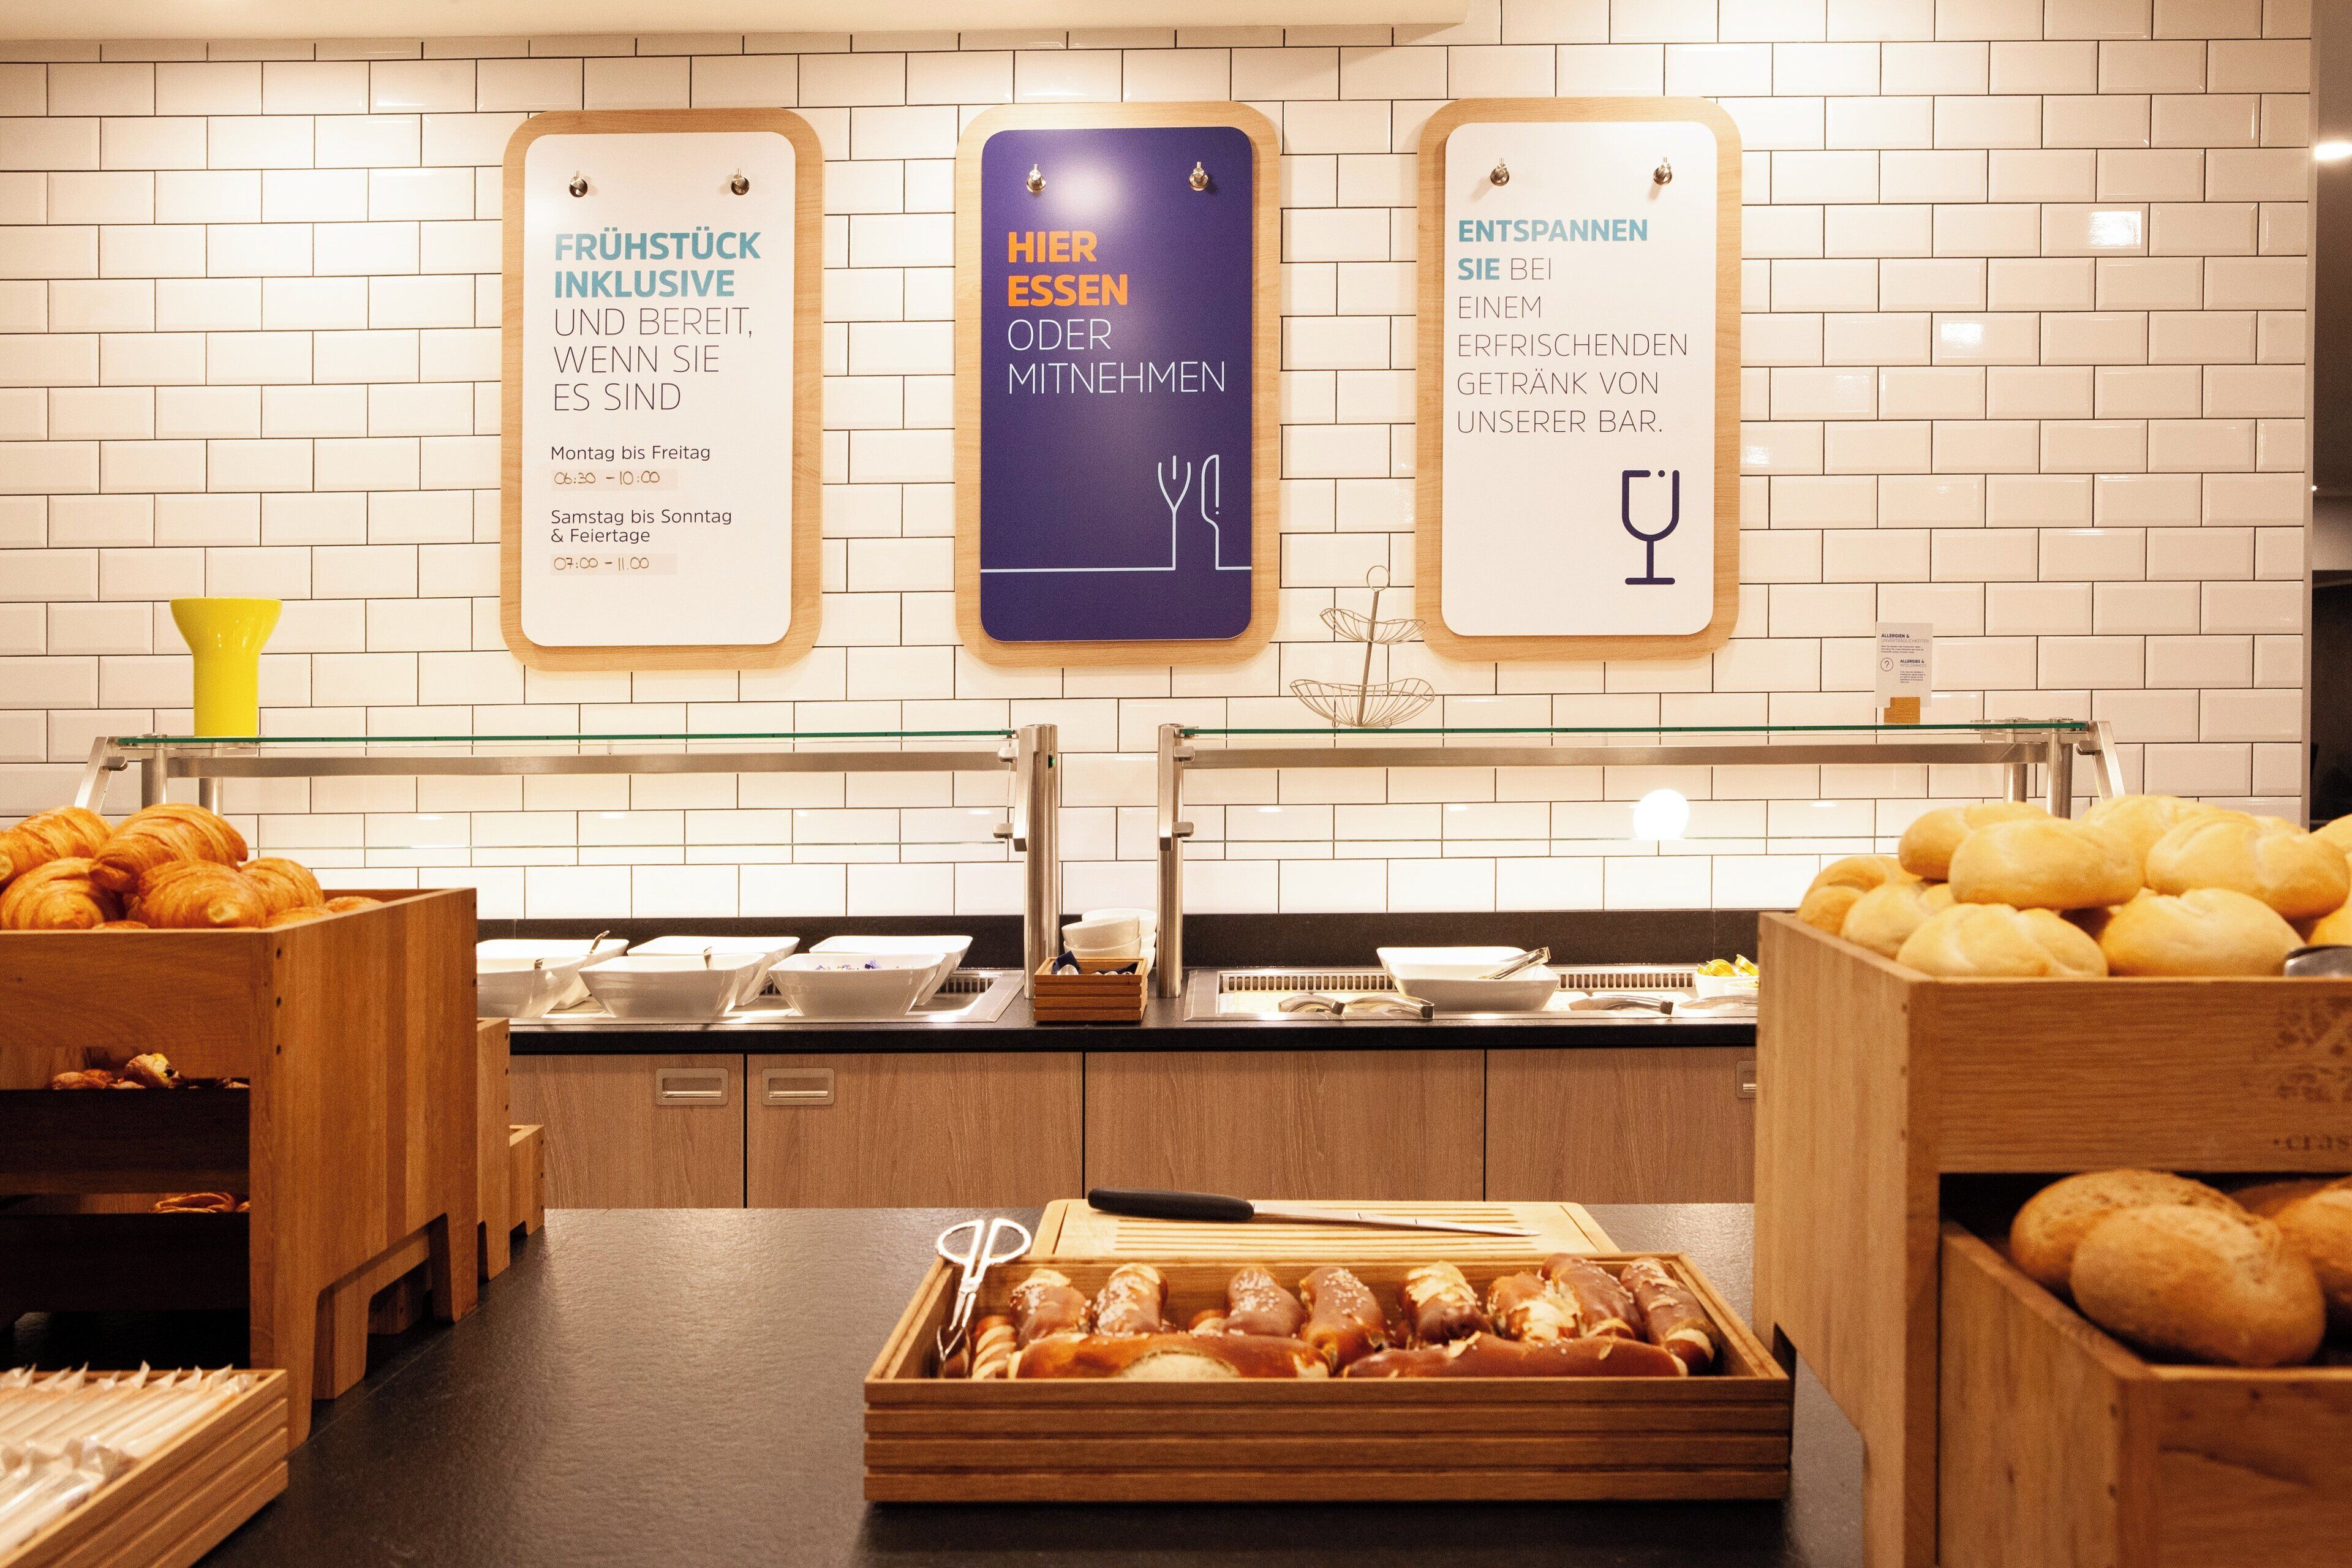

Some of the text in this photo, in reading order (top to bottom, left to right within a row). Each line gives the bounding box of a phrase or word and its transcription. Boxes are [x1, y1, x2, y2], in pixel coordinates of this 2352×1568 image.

[556, 226, 761, 260] FRÜHSTÜCK
[1459, 219, 1647, 242] ENTSPANNEN
[1008, 230, 1097, 263] HIER
[1458, 258, 1551, 281] SIE BEI
[556, 270, 734, 298] INKLUSIVE
[1008, 274, 1128, 307] ESSEN
[1459, 296, 1540, 318] EINEM
[556, 307, 752, 337] UND BEREIT,
[1008, 318, 1112, 351] ODER
[1459, 334, 1686, 356] ERFRISCHENDEN
[554, 345, 718, 373] WENN SIE
[1009, 361, 1224, 394] MITNEHMEN
[1458, 368, 1657, 395] GETRÄNK VON
[555, 383, 680, 411] ES SIND
[1458, 410, 1662, 433] UNSERER BAR.
[552, 445, 710, 462] Montag bis Freitag
[554, 472, 595, 484] 06:30
[620, 470, 660, 484] 10:00
[552, 509, 731, 526] Samstag bis Sonntag
[551, 529, 650, 544] & Feiertage
[554, 557, 598, 570] 07:00
